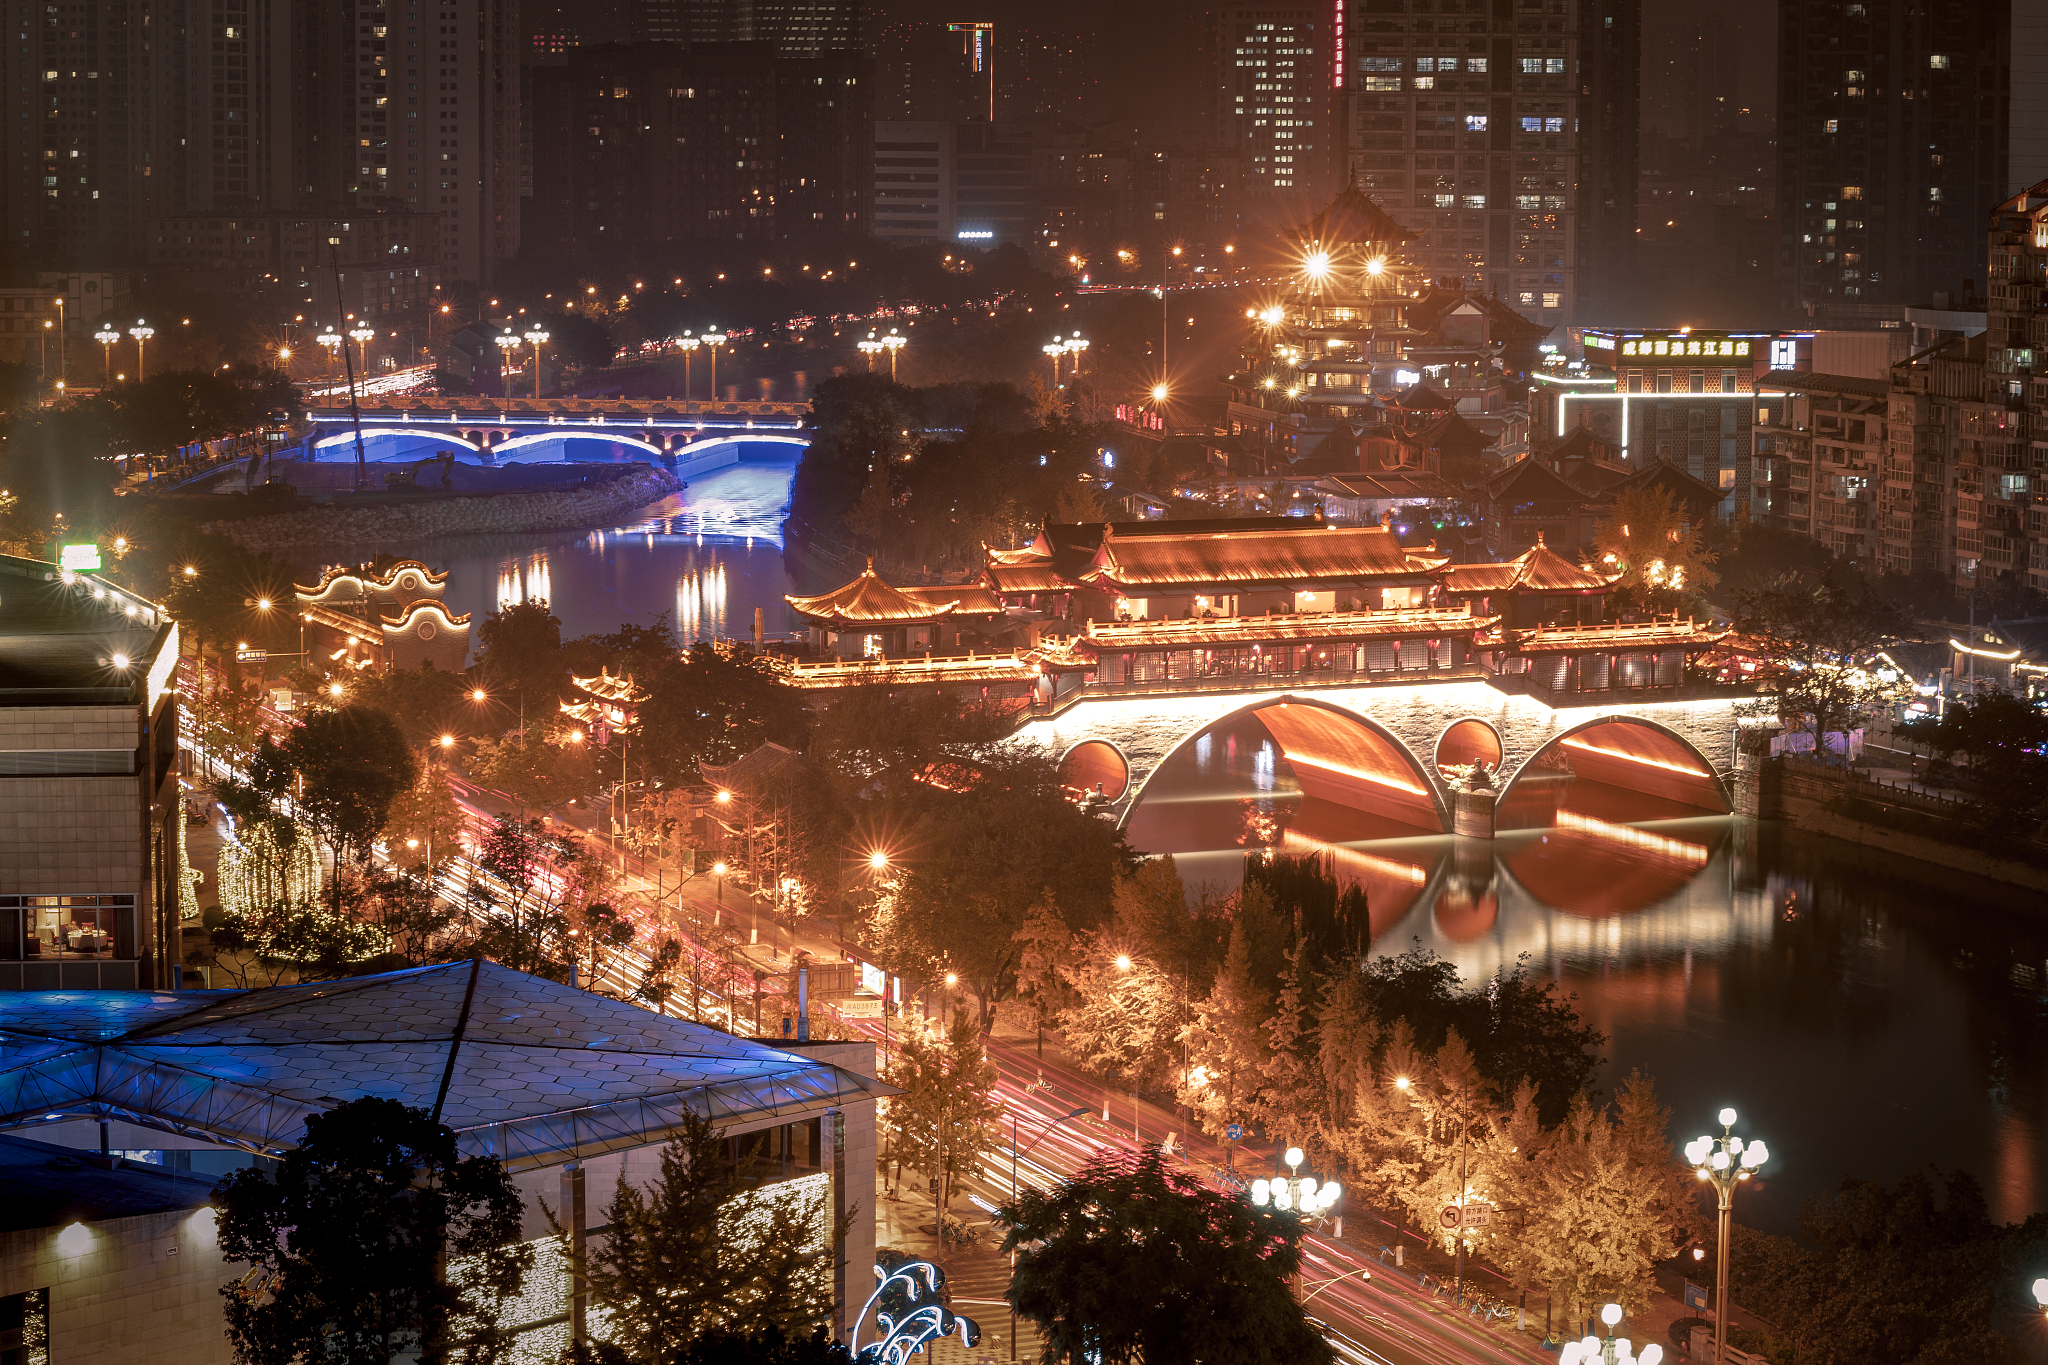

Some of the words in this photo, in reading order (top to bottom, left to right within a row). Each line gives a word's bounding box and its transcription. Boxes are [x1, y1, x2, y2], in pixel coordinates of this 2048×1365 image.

[1622, 341, 1750, 355] 成都丽澳滨江酒店
[1466, 1207, 1488, 1215] 前方路口
